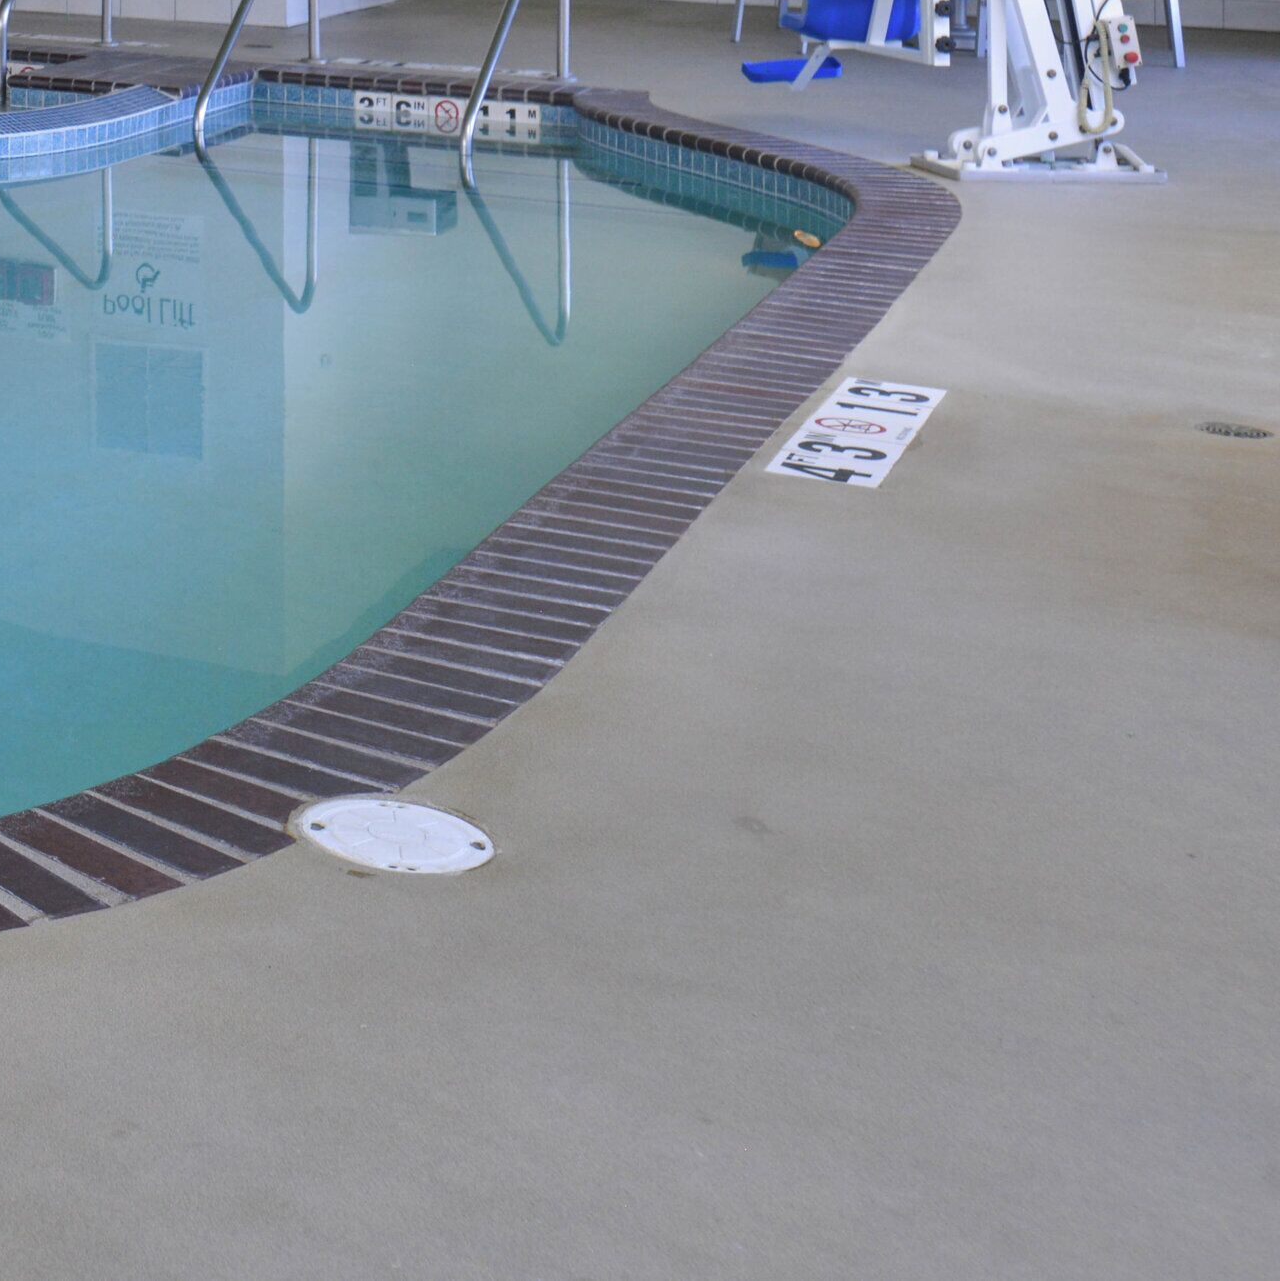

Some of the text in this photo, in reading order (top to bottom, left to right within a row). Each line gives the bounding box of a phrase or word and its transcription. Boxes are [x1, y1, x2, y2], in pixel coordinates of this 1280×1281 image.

[375, 97, 387, 107] FT
[413, 101, 425, 111] IN
[527, 109, 537, 118] M
[797, 440, 888, 461] 3
[780, 461, 872, 483] 4
